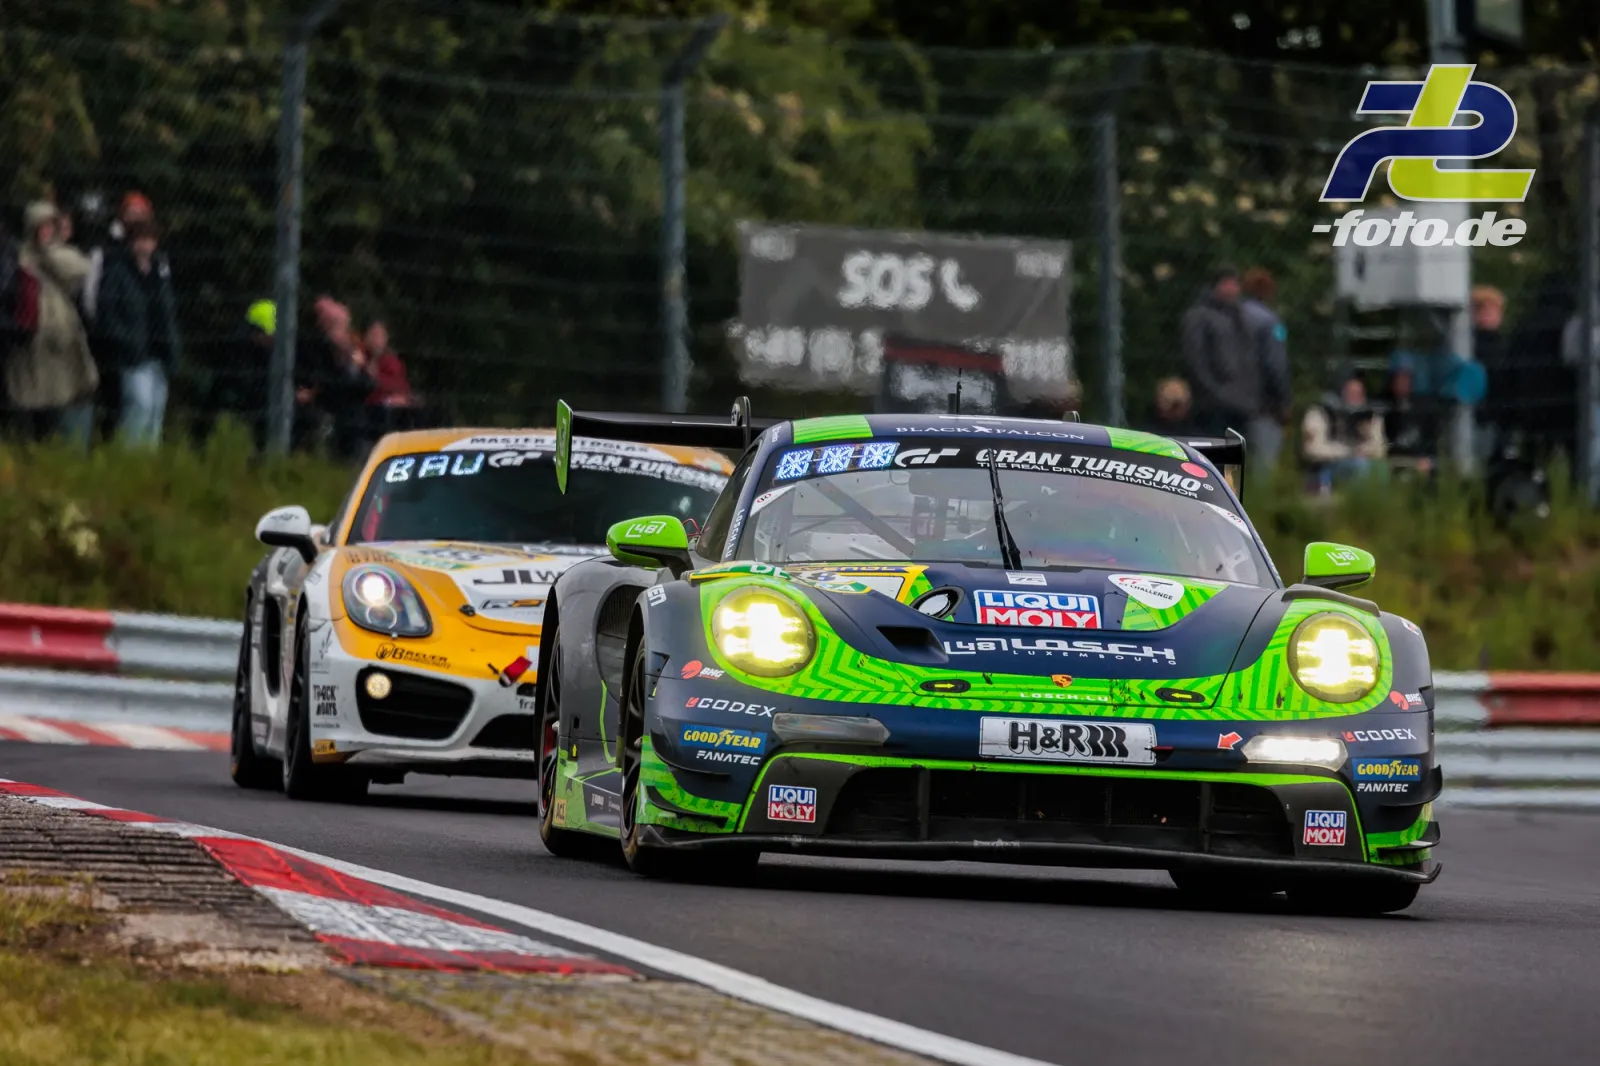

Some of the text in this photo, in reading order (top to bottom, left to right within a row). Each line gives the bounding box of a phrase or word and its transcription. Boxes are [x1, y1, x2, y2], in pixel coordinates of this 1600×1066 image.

[896, 426, 1085, 440] BLACK FALCON
[975, 448, 1202, 493] GRAN TURISMO
[1011, 463, 1050, 471] REAL
[1052, 466, 1112, 479] DRIVING
[1115, 474, 1199, 498] SIMULATOR
[1129, 584, 1175, 601] CHALLENGE
[984, 591, 1089, 612] LIQUI
[985, 609, 1096, 630] MOLY
[1011, 638, 1177, 660] LOSCH
[1013, 649, 1177, 665] LUXEMBOURG
[700, 666, 725, 678] BHG
[1020, 692, 1109, 701] LOSCH.LU
[697, 698, 776, 718] CODEX
[1009, 720, 1090, 757] H&R
[1354, 728, 1417, 741] CODEX
[696, 750, 762, 766] FANATEC
[771, 786, 814, 805] LIQUI
[1357, 783, 1409, 793] FANATEC
[769, 803, 815, 821] MOLY
[1307, 811, 1345, 828] LIQUI
[1306, 827, 1345, 844] MOLY
